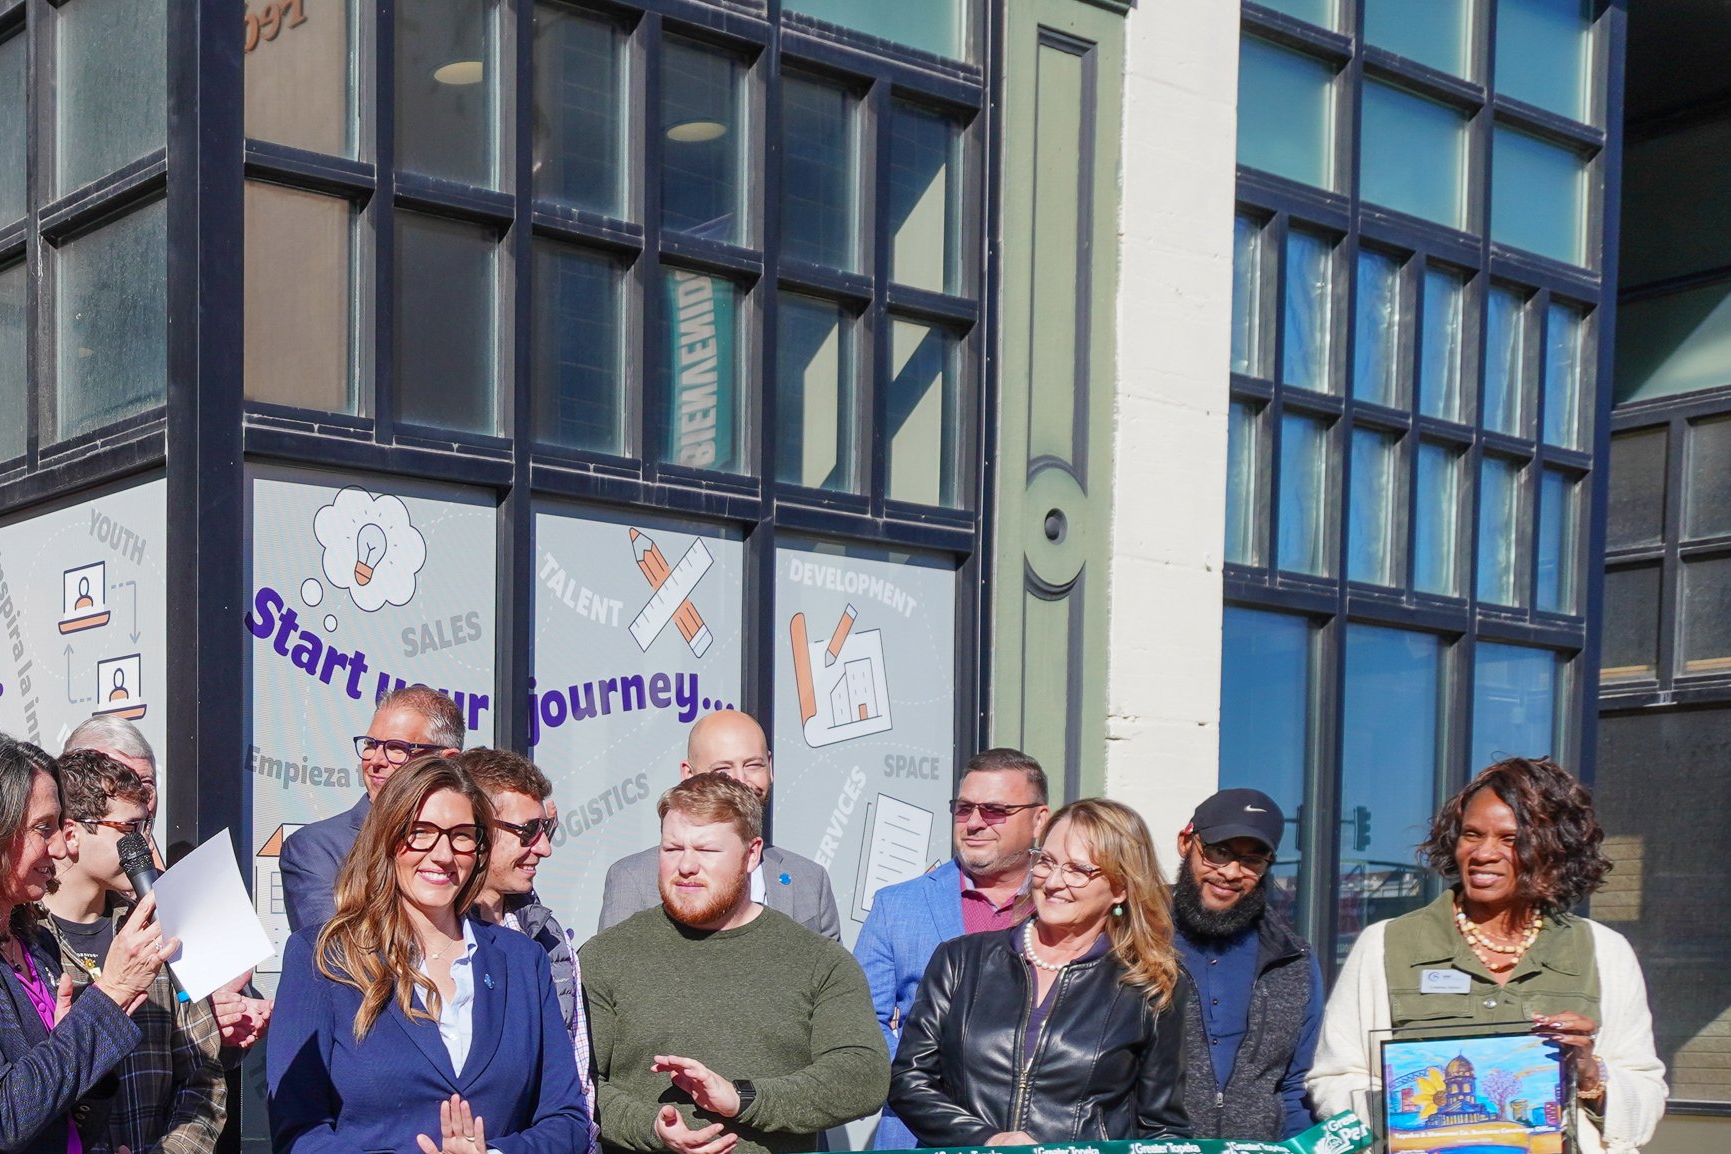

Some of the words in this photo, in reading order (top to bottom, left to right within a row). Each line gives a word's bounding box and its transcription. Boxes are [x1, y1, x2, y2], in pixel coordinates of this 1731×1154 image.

[88, 508, 146, 566] YOUTH
[539, 552, 624, 627] TALENT
[789, 558, 918, 619] DEVELOPMENT
[244, 587, 368, 700] Start
[401, 611, 482, 658] SALES
[17, 659, 34, 697] la
[244, 743, 351, 789] Empieza
[884, 754, 940, 780] SPACE
[550, 773, 650, 848] OGISTICS
[813, 765, 867, 871] ERVICES
[1135, 1143, 1168, 1154] Greater
